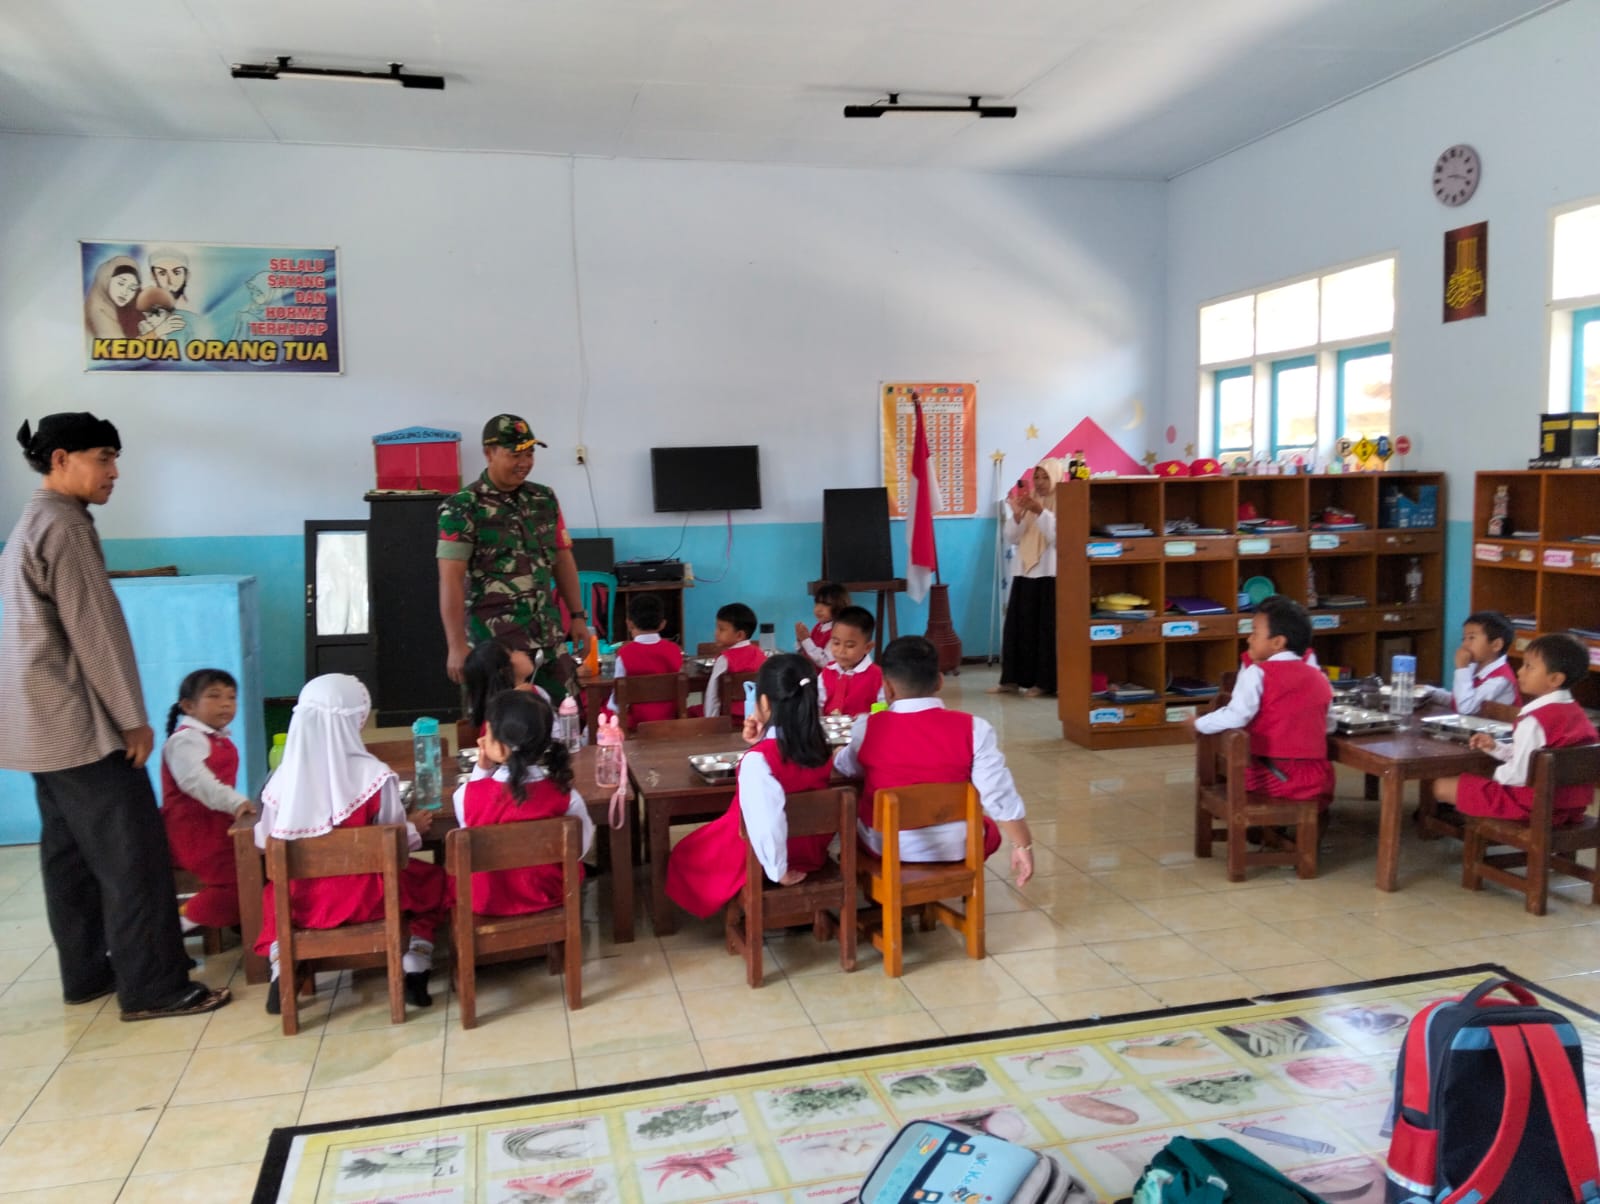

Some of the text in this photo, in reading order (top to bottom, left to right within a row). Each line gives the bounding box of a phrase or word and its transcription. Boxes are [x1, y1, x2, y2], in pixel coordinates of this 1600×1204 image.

[269, 258, 326, 273] SELALU
[267, 274, 326, 288] SAYANG
[295, 291, 327, 304] DAN
[264, 306, 328, 320] HORMAT
[249, 321, 329, 336] TERHADAP
[92, 338, 329, 361] KEDUA ORANG TUA
